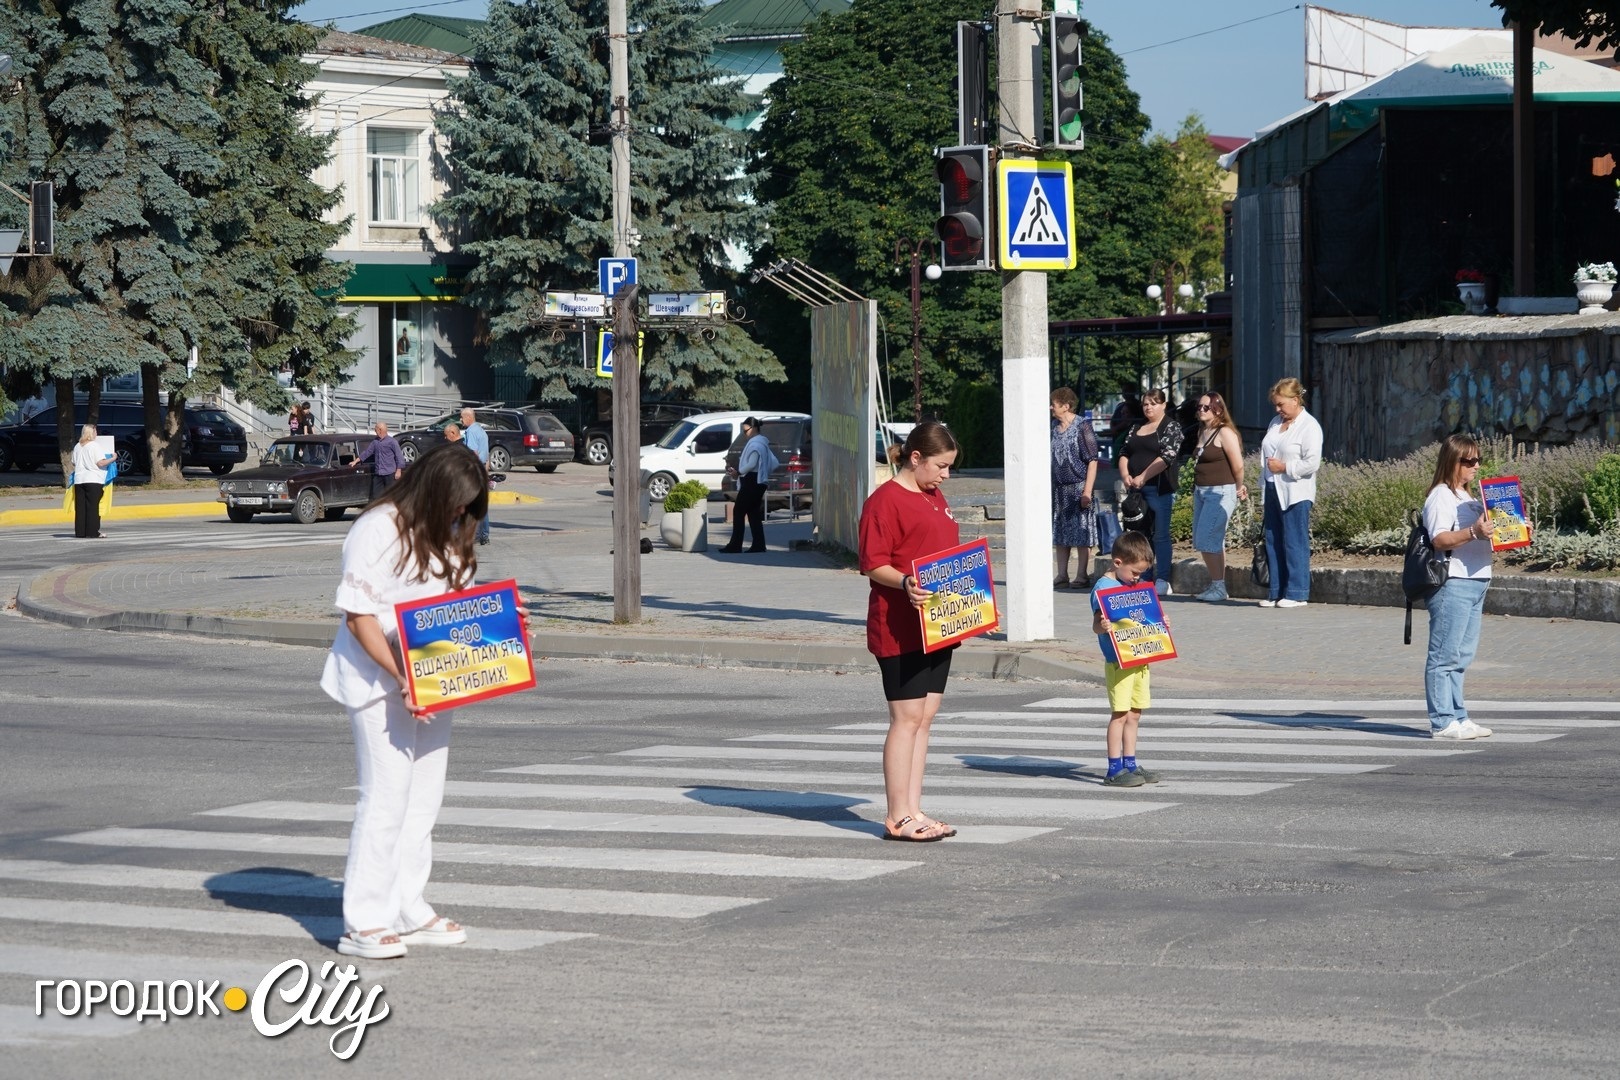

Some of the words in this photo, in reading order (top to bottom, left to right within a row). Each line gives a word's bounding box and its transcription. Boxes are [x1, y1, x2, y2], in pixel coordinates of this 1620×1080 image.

[919, 562, 953, 586] ВИЙДИ
[953, 560, 961, 575] З
[962, 550, 987, 572] АВТО!
[938, 581, 952, 598] НЕ
[952, 575, 976, 594] БУДЬ
[414, 594, 503, 631] ЗУПИНИСЬ!
[930, 589, 986, 621] БАЙДУЖИМ!
[450, 623, 482, 646] 9:00
[940, 609, 983, 637] ВШАНУЙ!
[1114, 624, 1143, 643] ВШАНУЙ
[414, 648, 469, 678] ВШАНУЙ
[440, 665, 508, 696] ЗАГИБЛИХ!
